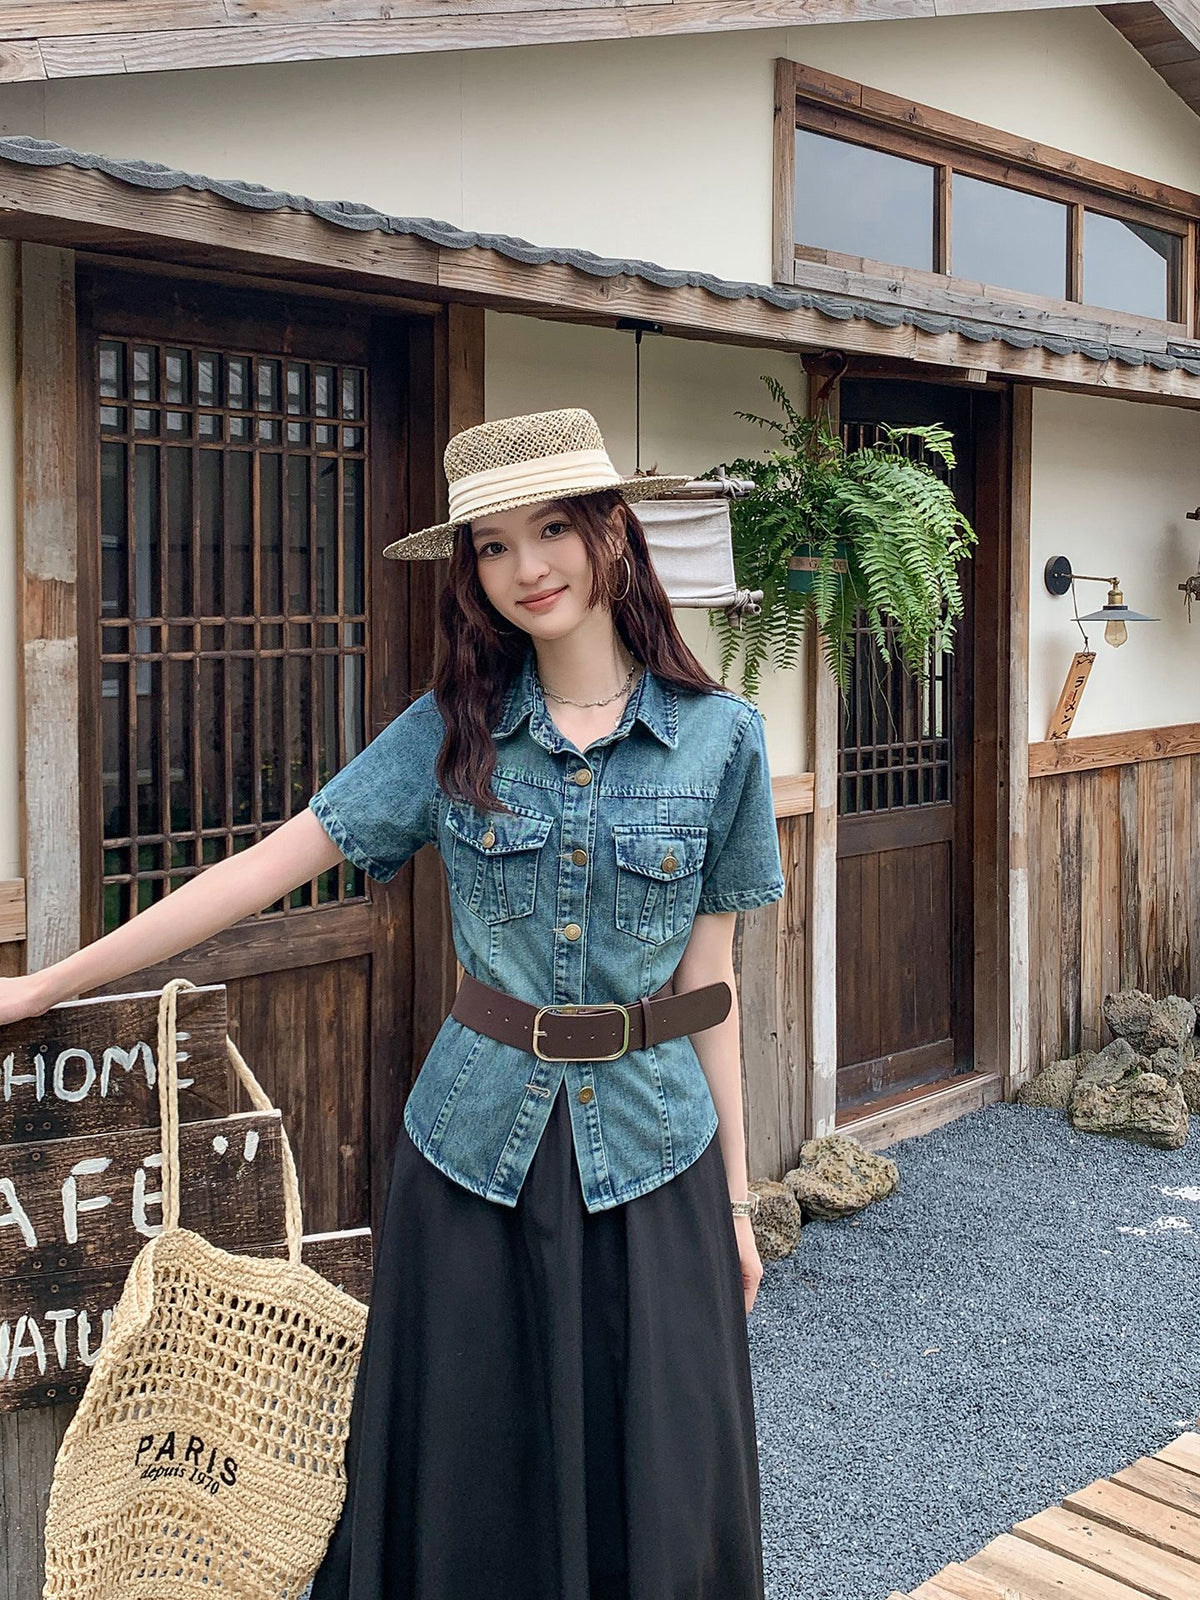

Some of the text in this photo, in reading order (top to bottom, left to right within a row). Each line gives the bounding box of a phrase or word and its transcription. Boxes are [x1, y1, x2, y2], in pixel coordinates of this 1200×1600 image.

[1061, 675, 1086, 725] ラーメン
[0, 1305, 118, 1381] ATU
[134, 1431, 238, 1486] PARIS
[140, 1463, 220, 1495] depuis 1970
